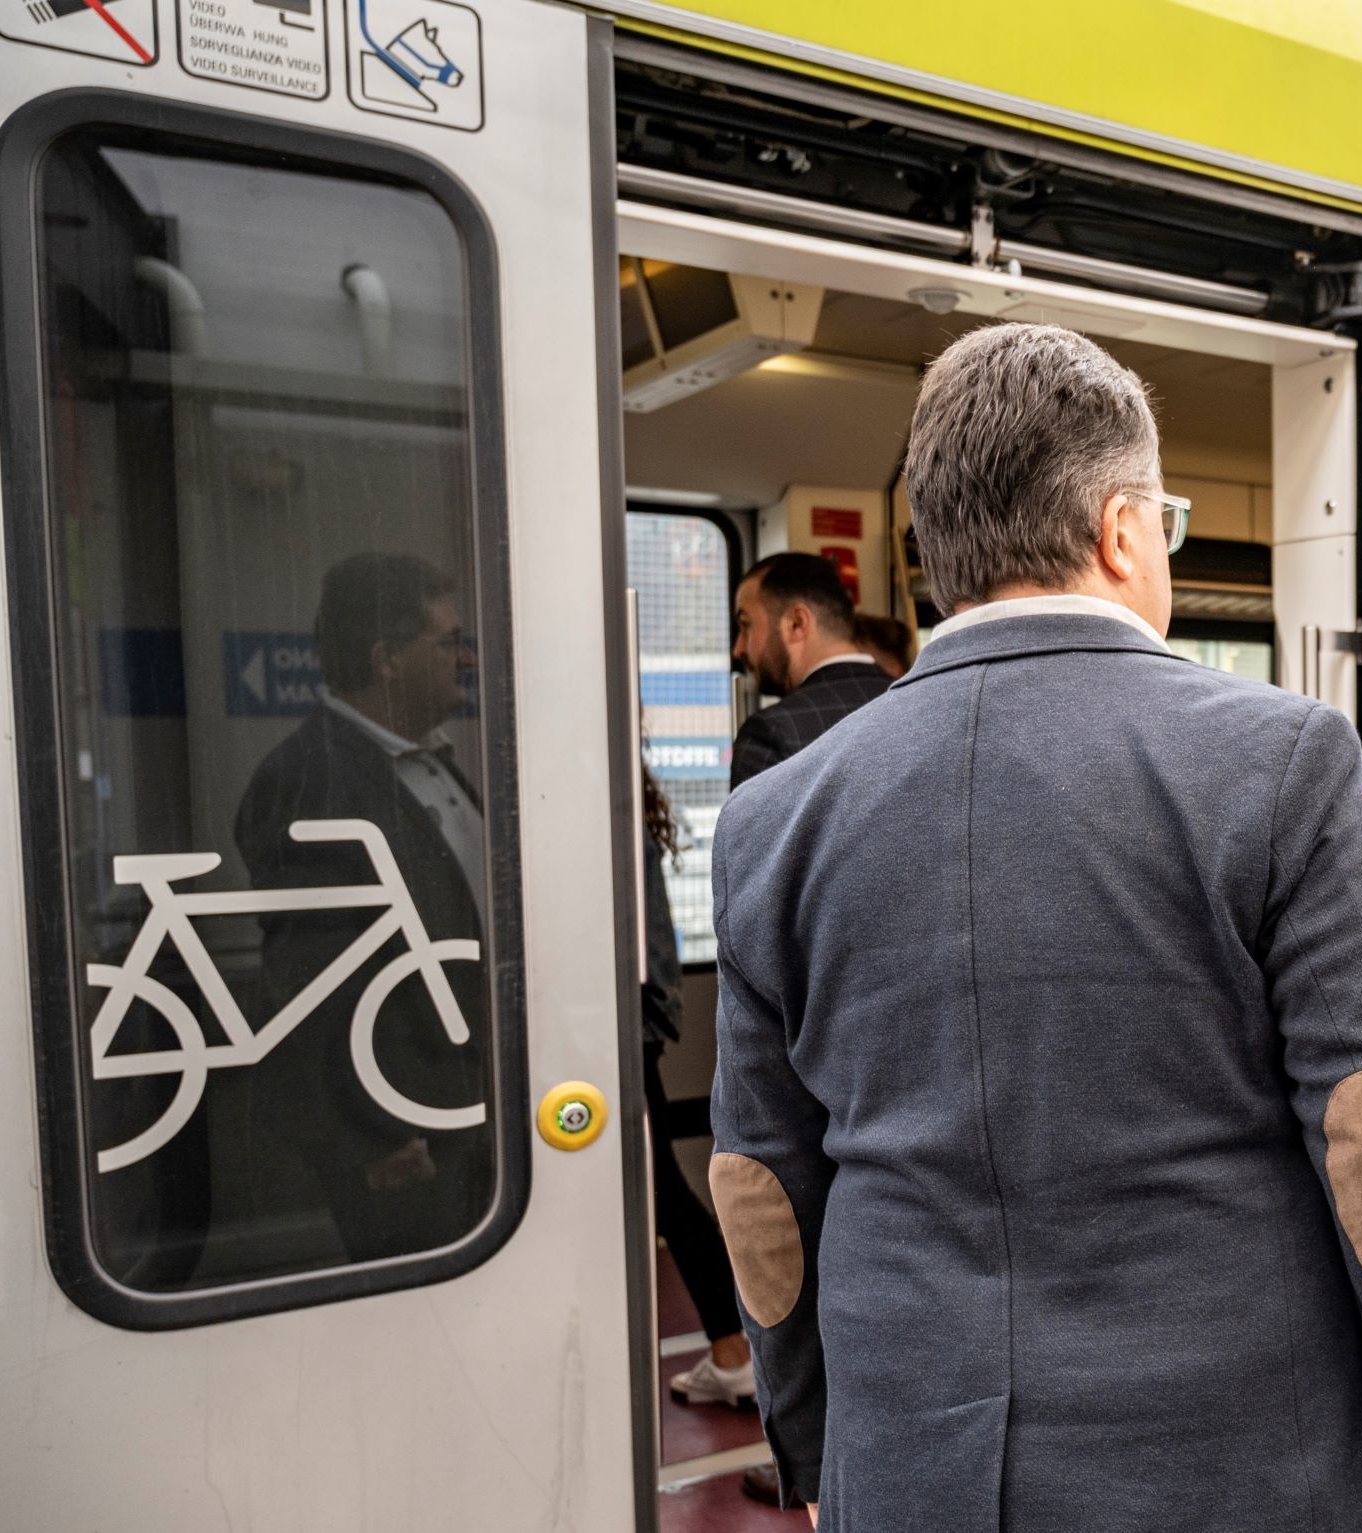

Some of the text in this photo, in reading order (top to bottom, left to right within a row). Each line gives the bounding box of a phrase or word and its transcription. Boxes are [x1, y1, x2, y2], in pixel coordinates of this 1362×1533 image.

[190, 0, 226, 17] VIDEO
[190, 35, 322, 75] SORVEGLIANZA VIDEO
[191, 56, 318, 93] VIDEO SURVEILLANCE
